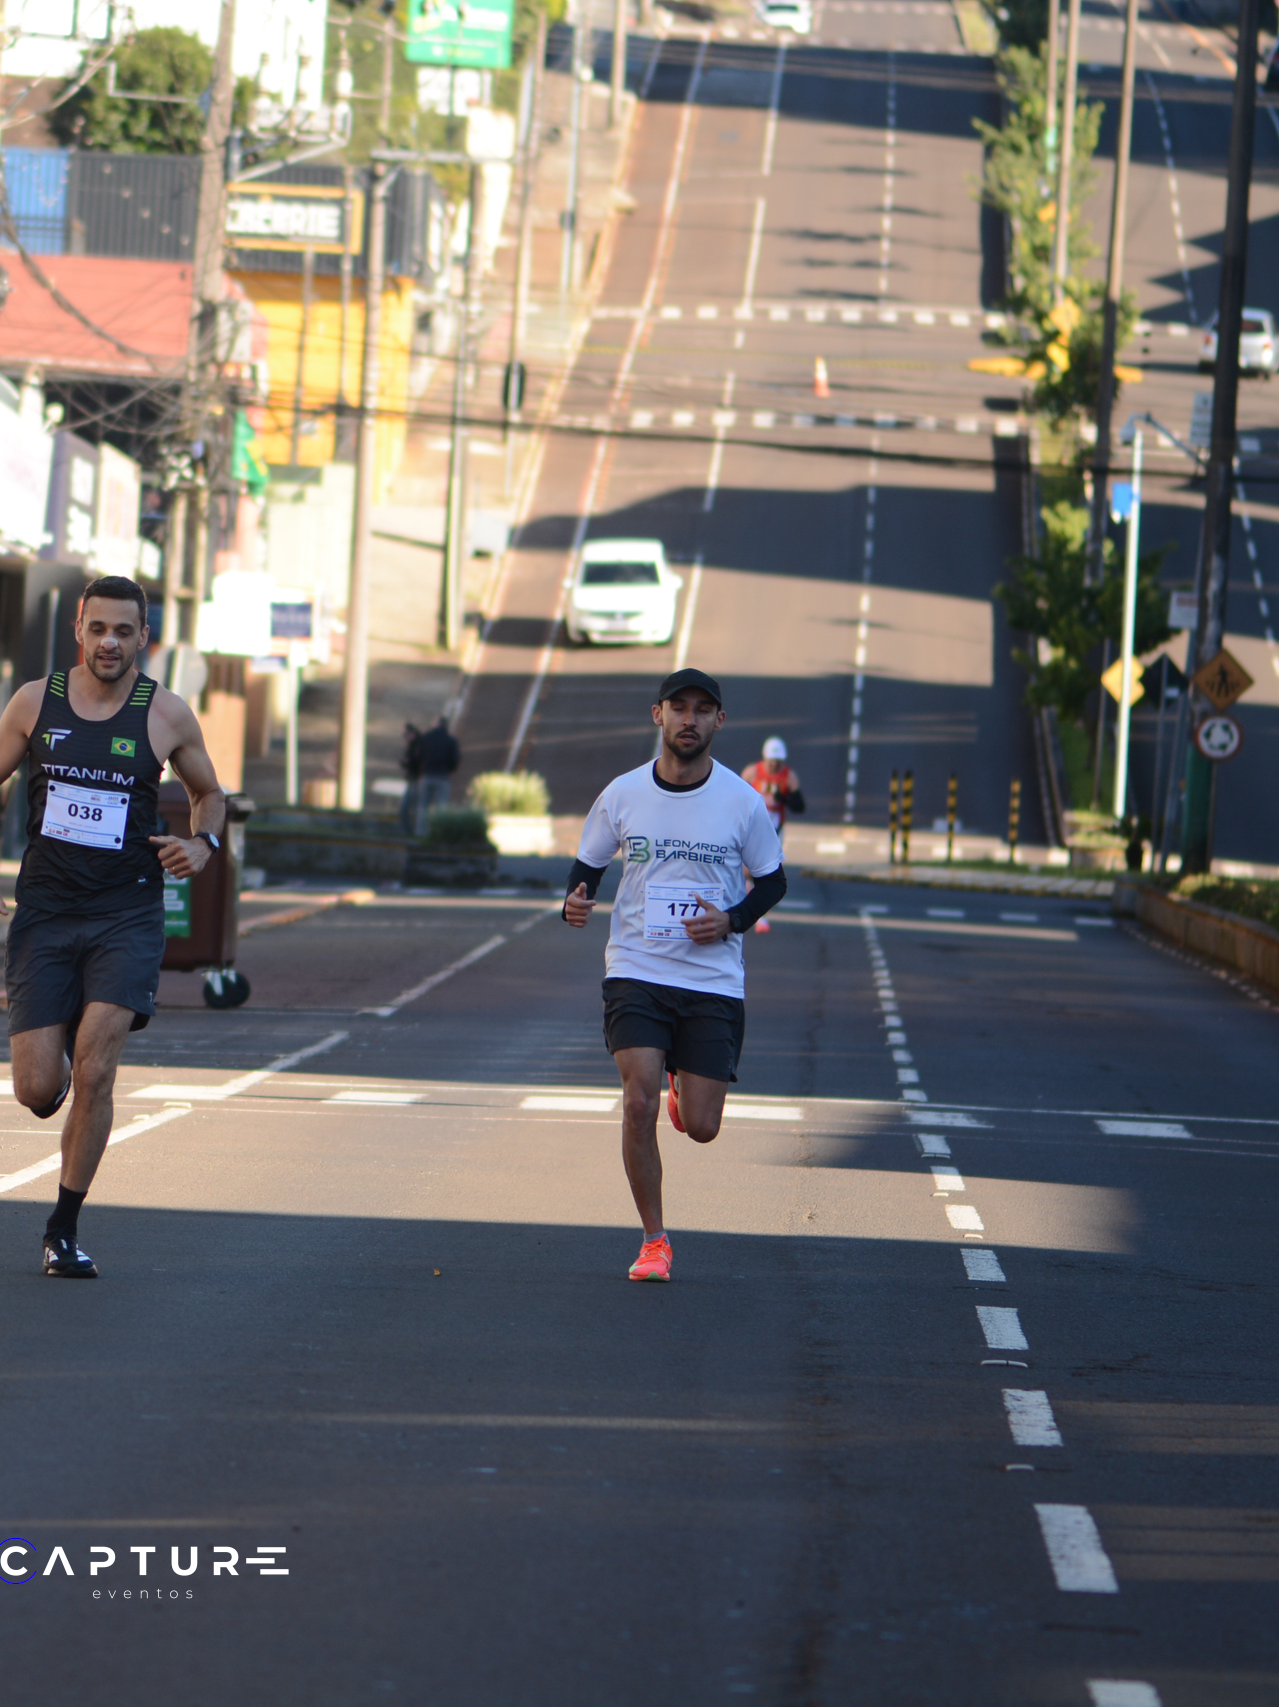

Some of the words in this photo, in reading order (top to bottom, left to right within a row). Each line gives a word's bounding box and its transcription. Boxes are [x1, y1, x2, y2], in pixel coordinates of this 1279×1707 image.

[41, 763, 135, 786] TITANIUM
[68, 803, 103, 822] 038
[655, 839, 728, 854] LEONARDO
[655, 849, 726, 865] BARBIERI
[667, 902, 701, 917] 177
